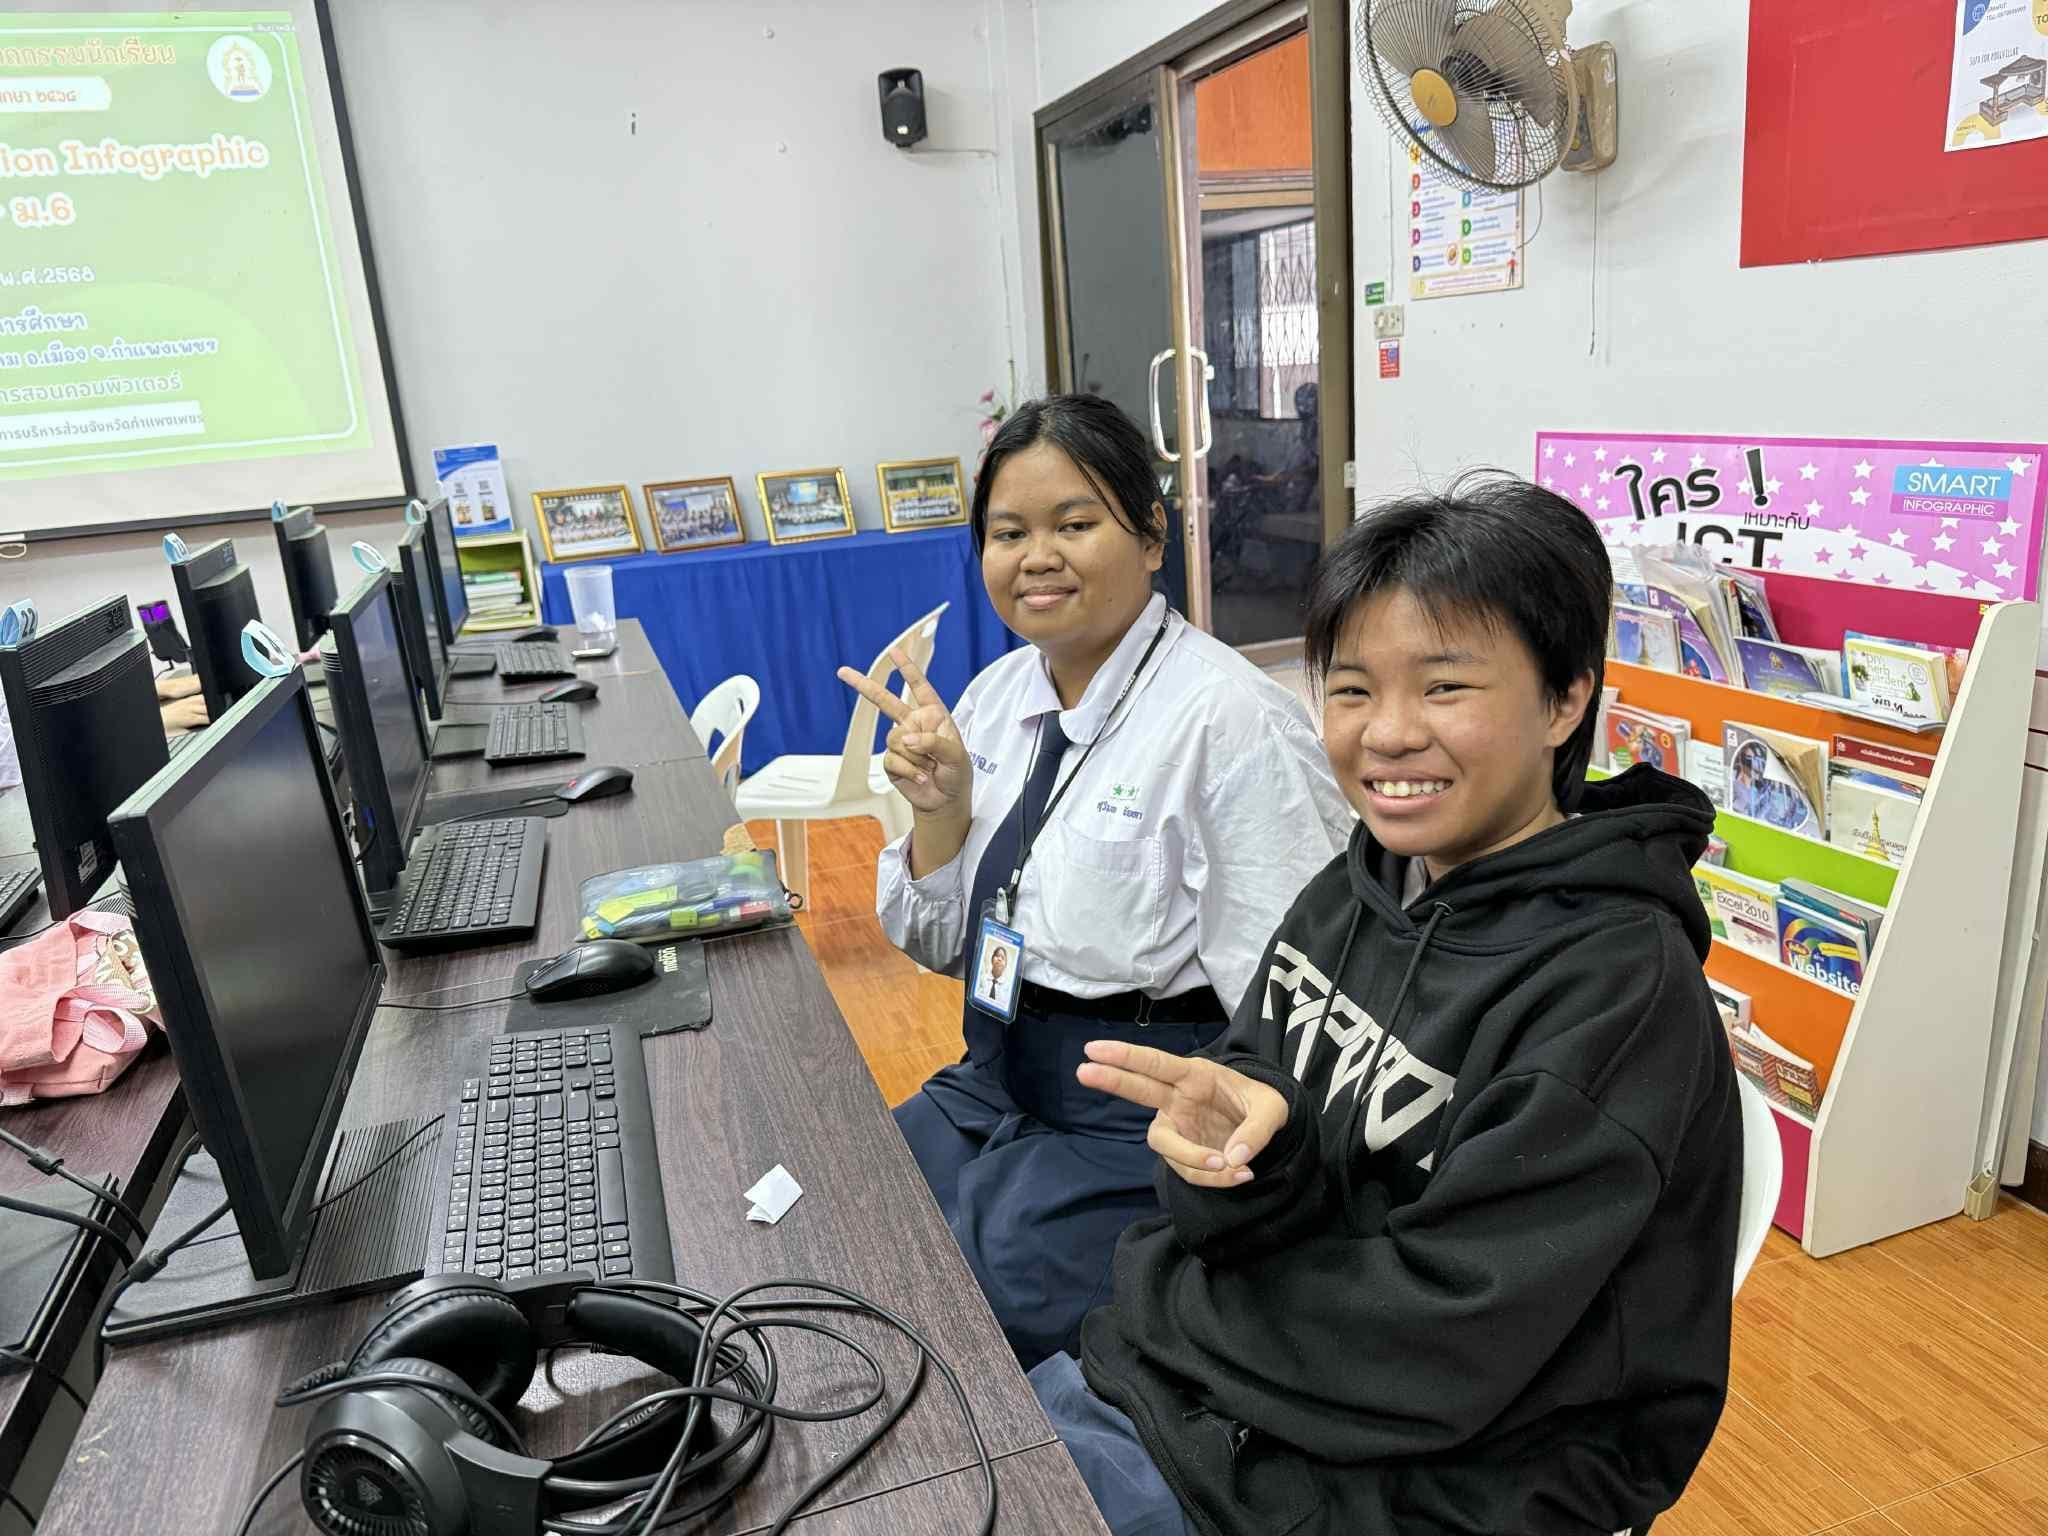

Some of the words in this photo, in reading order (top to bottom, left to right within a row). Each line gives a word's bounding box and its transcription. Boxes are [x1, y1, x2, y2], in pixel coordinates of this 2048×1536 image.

[0, 38, 176, 65] ตกรรมนักเรียน
[63, 137, 266, 176] Infographic
[1615, 464, 1721, 521] ใคร
[1907, 471, 2002, 498] SMART
[1903, 499, 1995, 516] INFOGRAPHIC
[1744, 903, 1769, 922] 2010
[1789, 950, 1860, 994] Website
